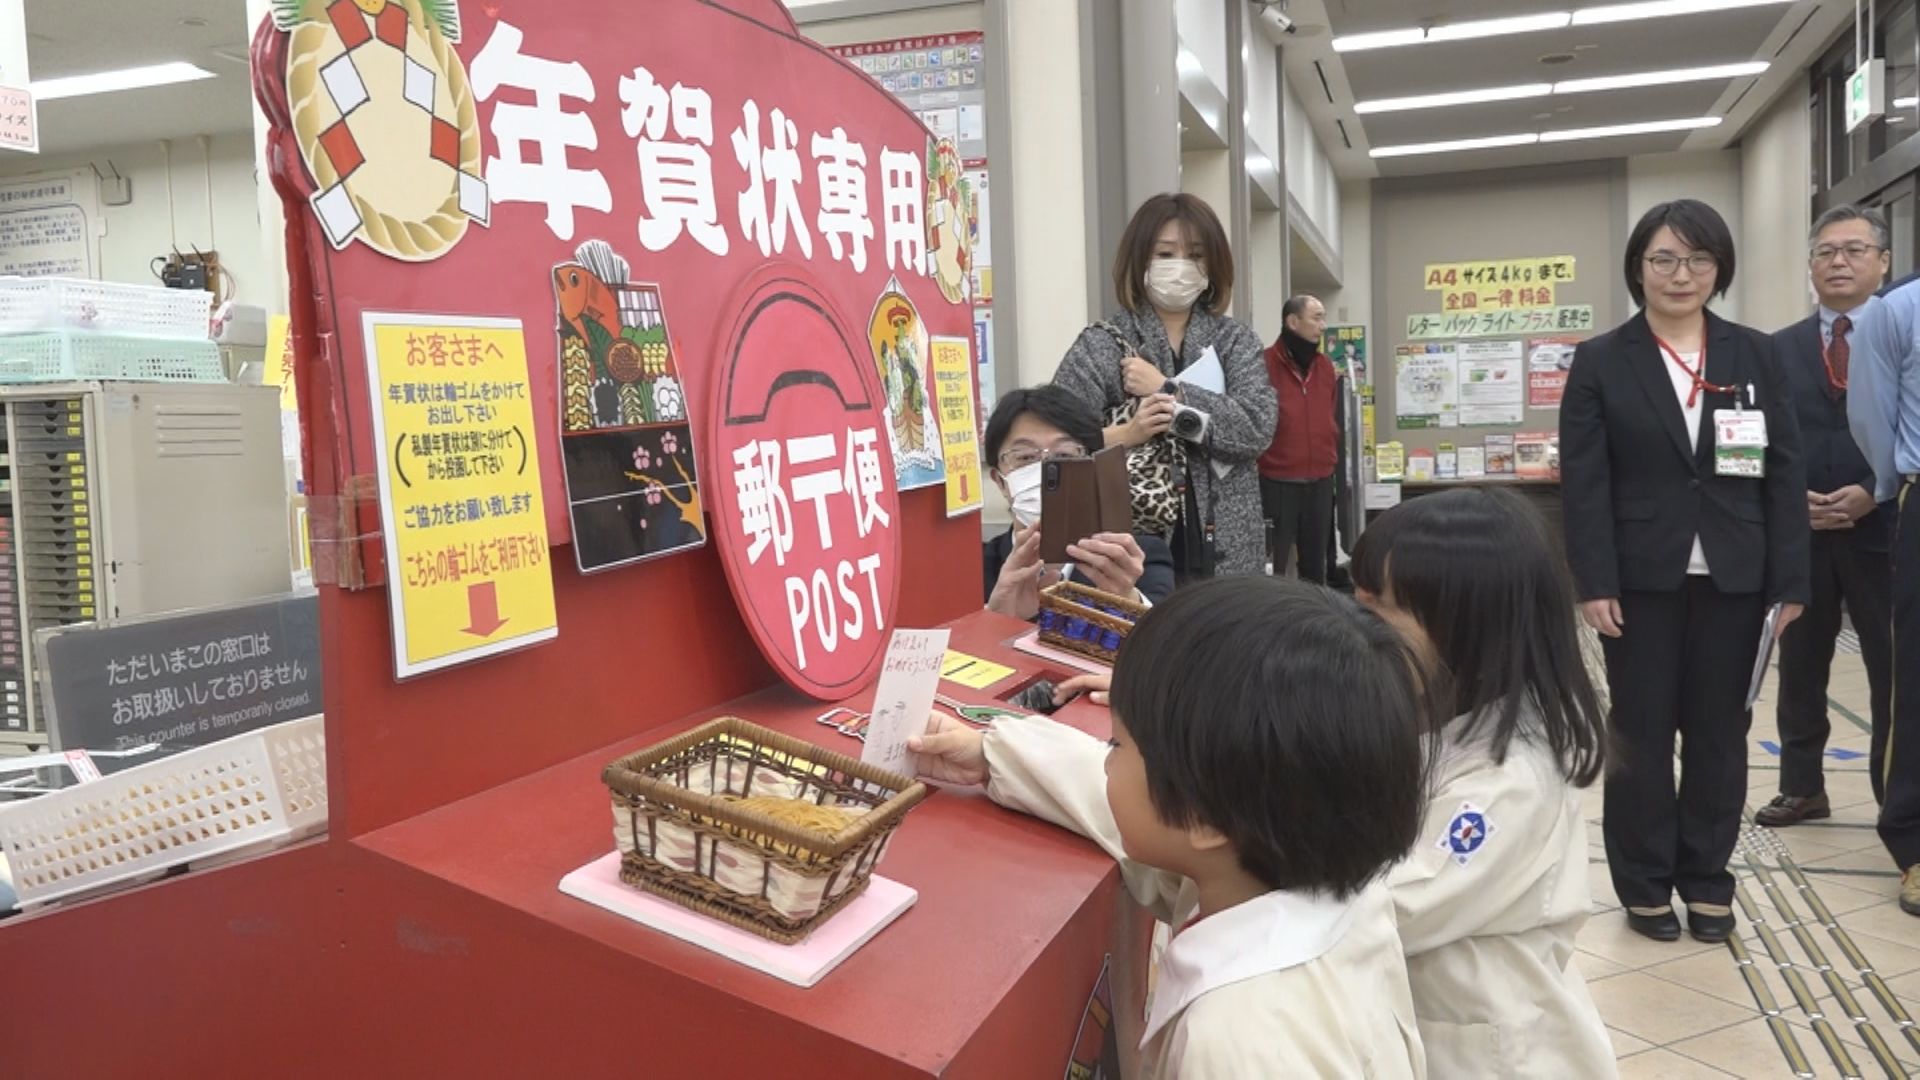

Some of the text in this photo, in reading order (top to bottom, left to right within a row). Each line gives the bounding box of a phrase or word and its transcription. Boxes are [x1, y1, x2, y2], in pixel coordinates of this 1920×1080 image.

[470, 19, 926, 277] 年賀状専用
[1427, 268, 1457, 286] A4
[405, 332, 504, 367] お客さまへ
[388, 381, 526, 405] 年賀状は輪ゴムをかけて
[427, 404, 498, 426] お出し下さい
[404, 491, 533, 529] ご協力をお願い致します
[407, 530, 547, 588] こちらの輪ゴムをご利用下さい
[784, 553, 884, 671] POST
[107, 632, 271, 685] ただいまこの窓口は
[111, 659, 308, 725] お取扱いしておりません
[149, 720, 196, 744] counter
[199, 717, 209, 731] is
[212, 701, 274, 728] temporarily
